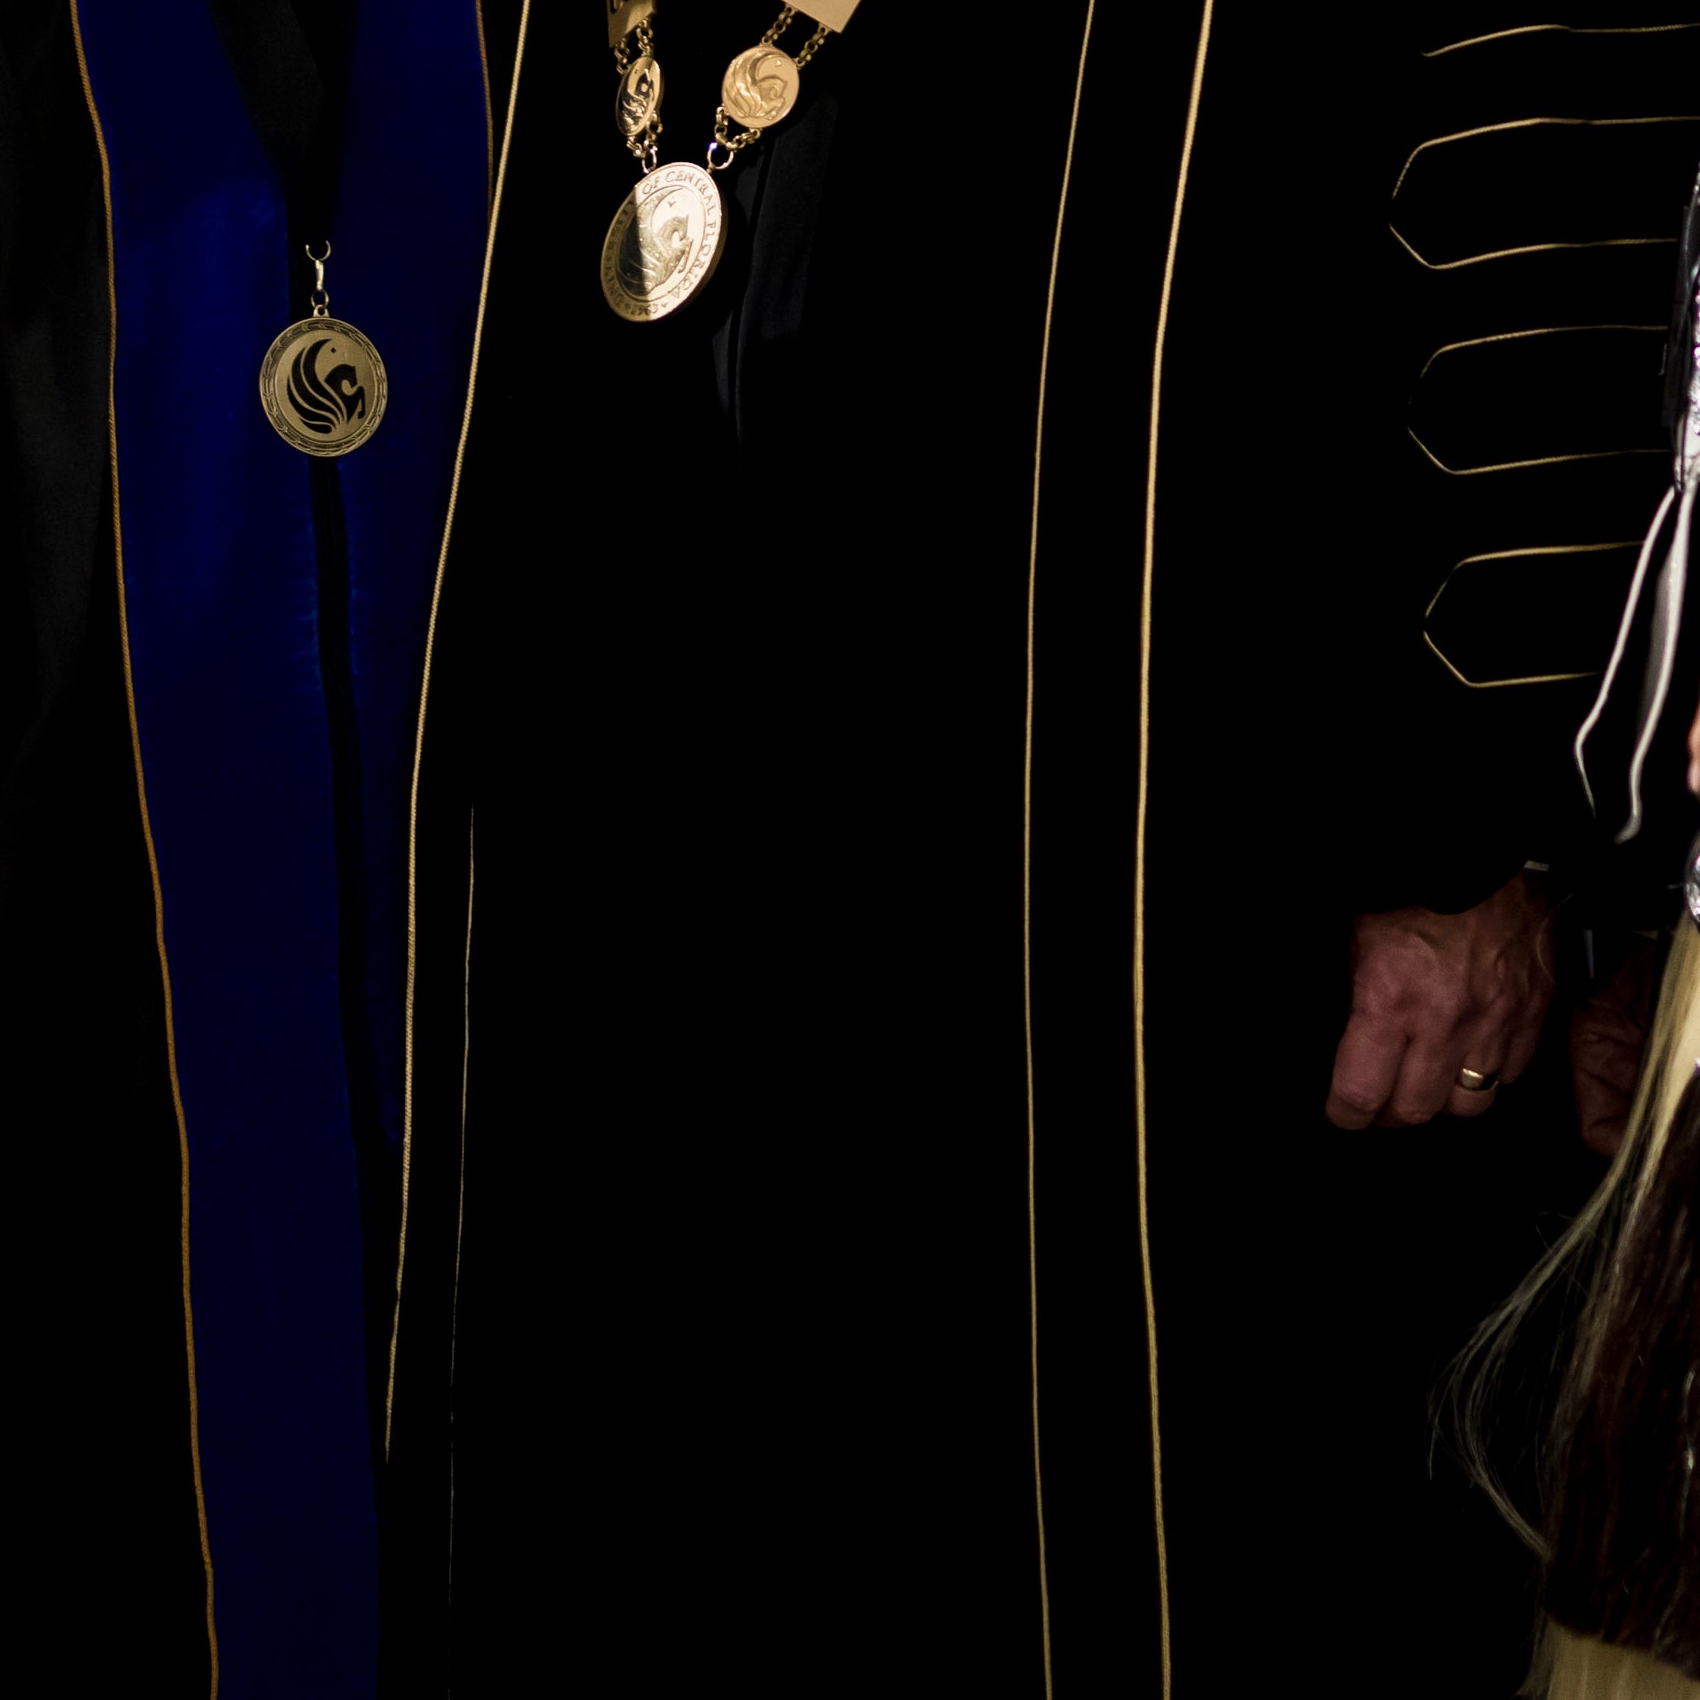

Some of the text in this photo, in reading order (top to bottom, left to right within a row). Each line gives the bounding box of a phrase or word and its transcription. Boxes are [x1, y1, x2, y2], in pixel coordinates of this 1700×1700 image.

[641, 175, 661, 196] OF
[664, 170, 717, 218] CENTRAL
[670, 221, 717, 300] FLORIDA
